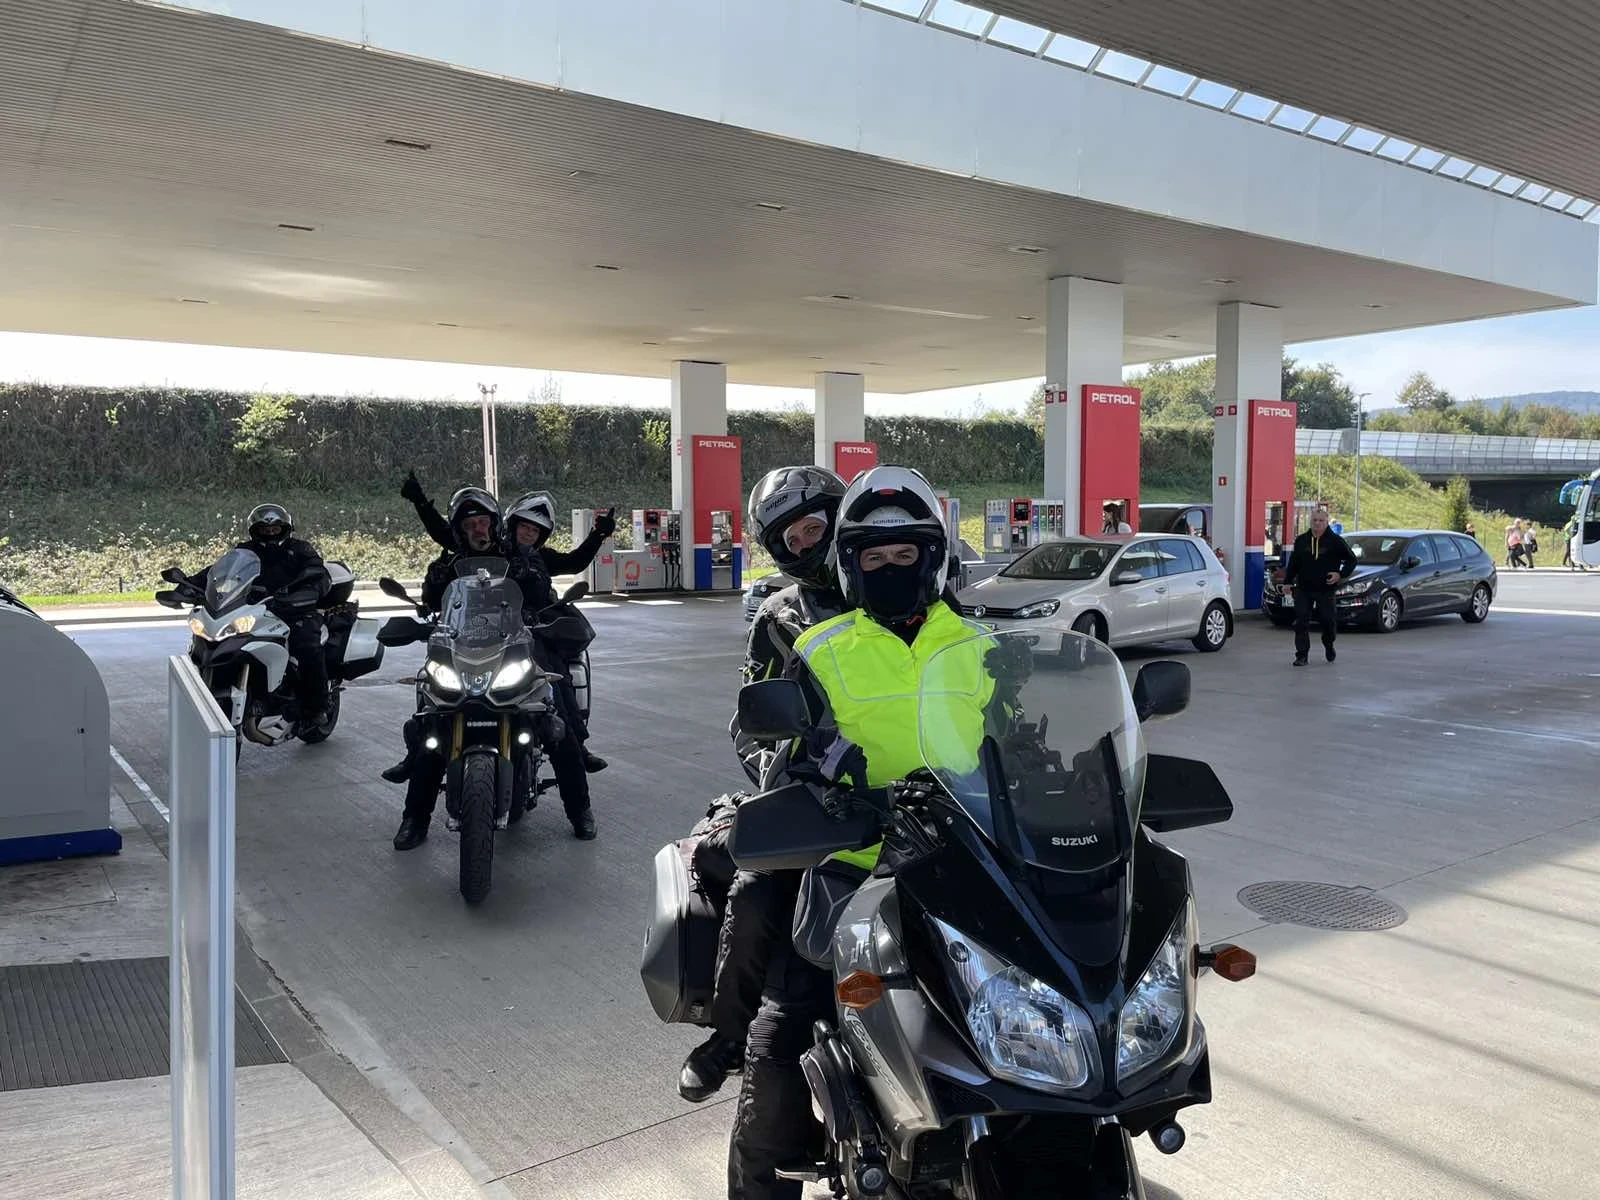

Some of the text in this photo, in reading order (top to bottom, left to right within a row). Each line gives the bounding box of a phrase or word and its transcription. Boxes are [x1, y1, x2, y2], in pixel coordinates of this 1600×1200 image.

[1091, 392, 1136, 405] PETROL
[1257, 406, 1293, 417] PETROL
[699, 440, 737, 449] PETROL
[841, 446, 873, 454] PETROL
[1051, 834, 1099, 846] SUZUKI
